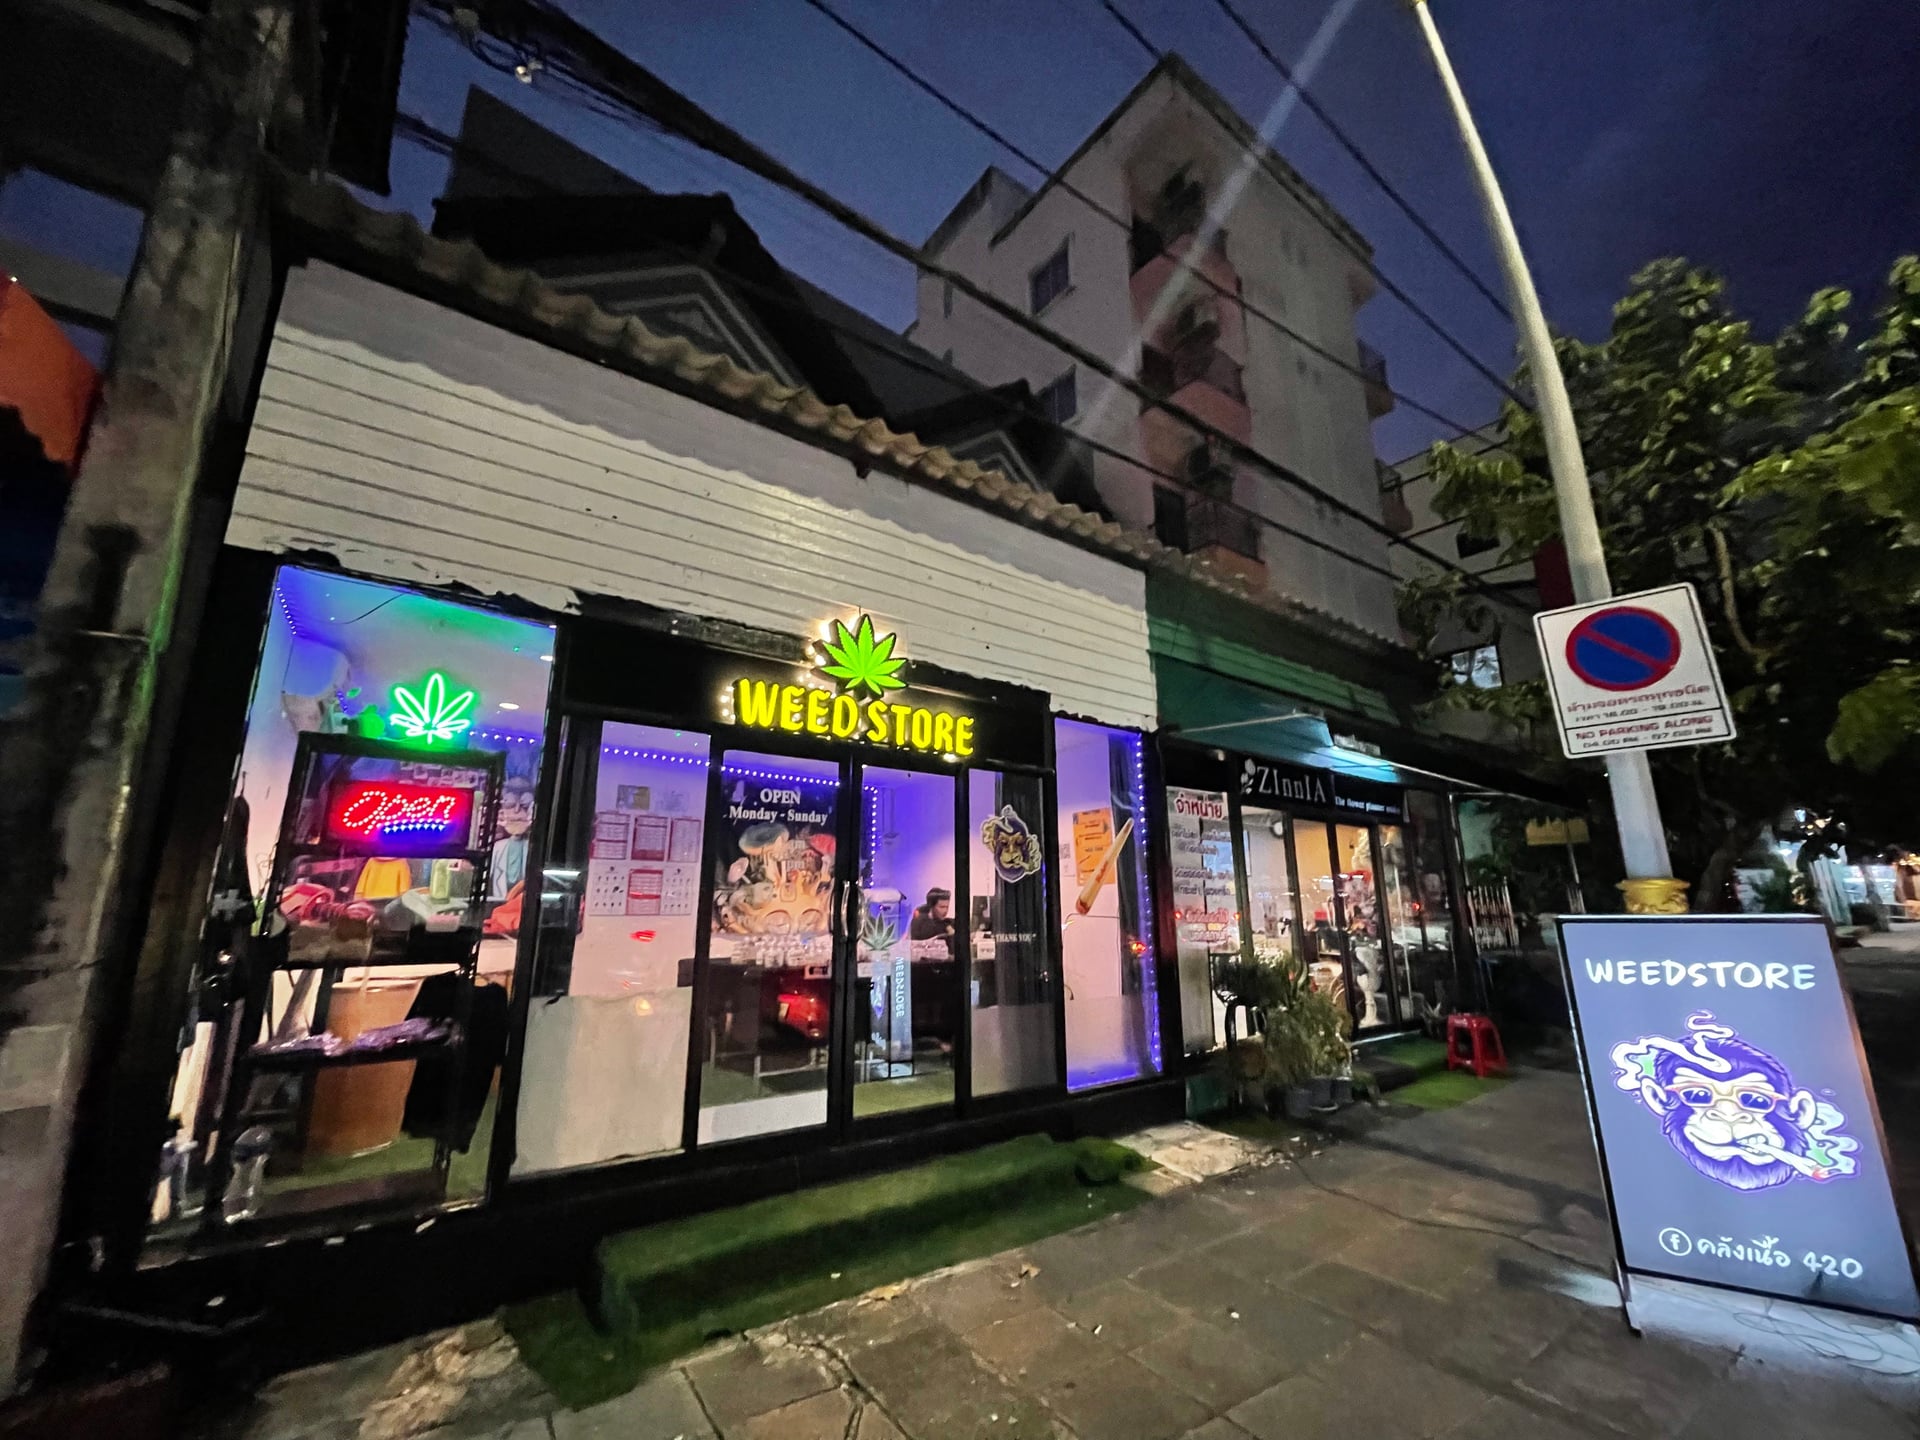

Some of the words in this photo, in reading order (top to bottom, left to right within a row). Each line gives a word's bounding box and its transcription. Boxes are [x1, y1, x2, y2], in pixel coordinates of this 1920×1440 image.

[739, 678, 858, 737] WEED
[867, 699, 975, 755] STORE
[1576, 731, 1595, 740] NO
[1599, 722, 1660, 736] PARKING
[759, 787, 801, 805] OPEN
[1174, 792, 1223, 819] จำหน่าย
[342, 790, 456, 835] Open
[729, 805, 777, 823] Monday
[787, 809, 828, 826] Sunday
[1585, 958, 1816, 990] WEEDSTORE
[1697, 1234, 1791, 1268] คลังเนื้อ
[1802, 1251, 1864, 1279] 420
